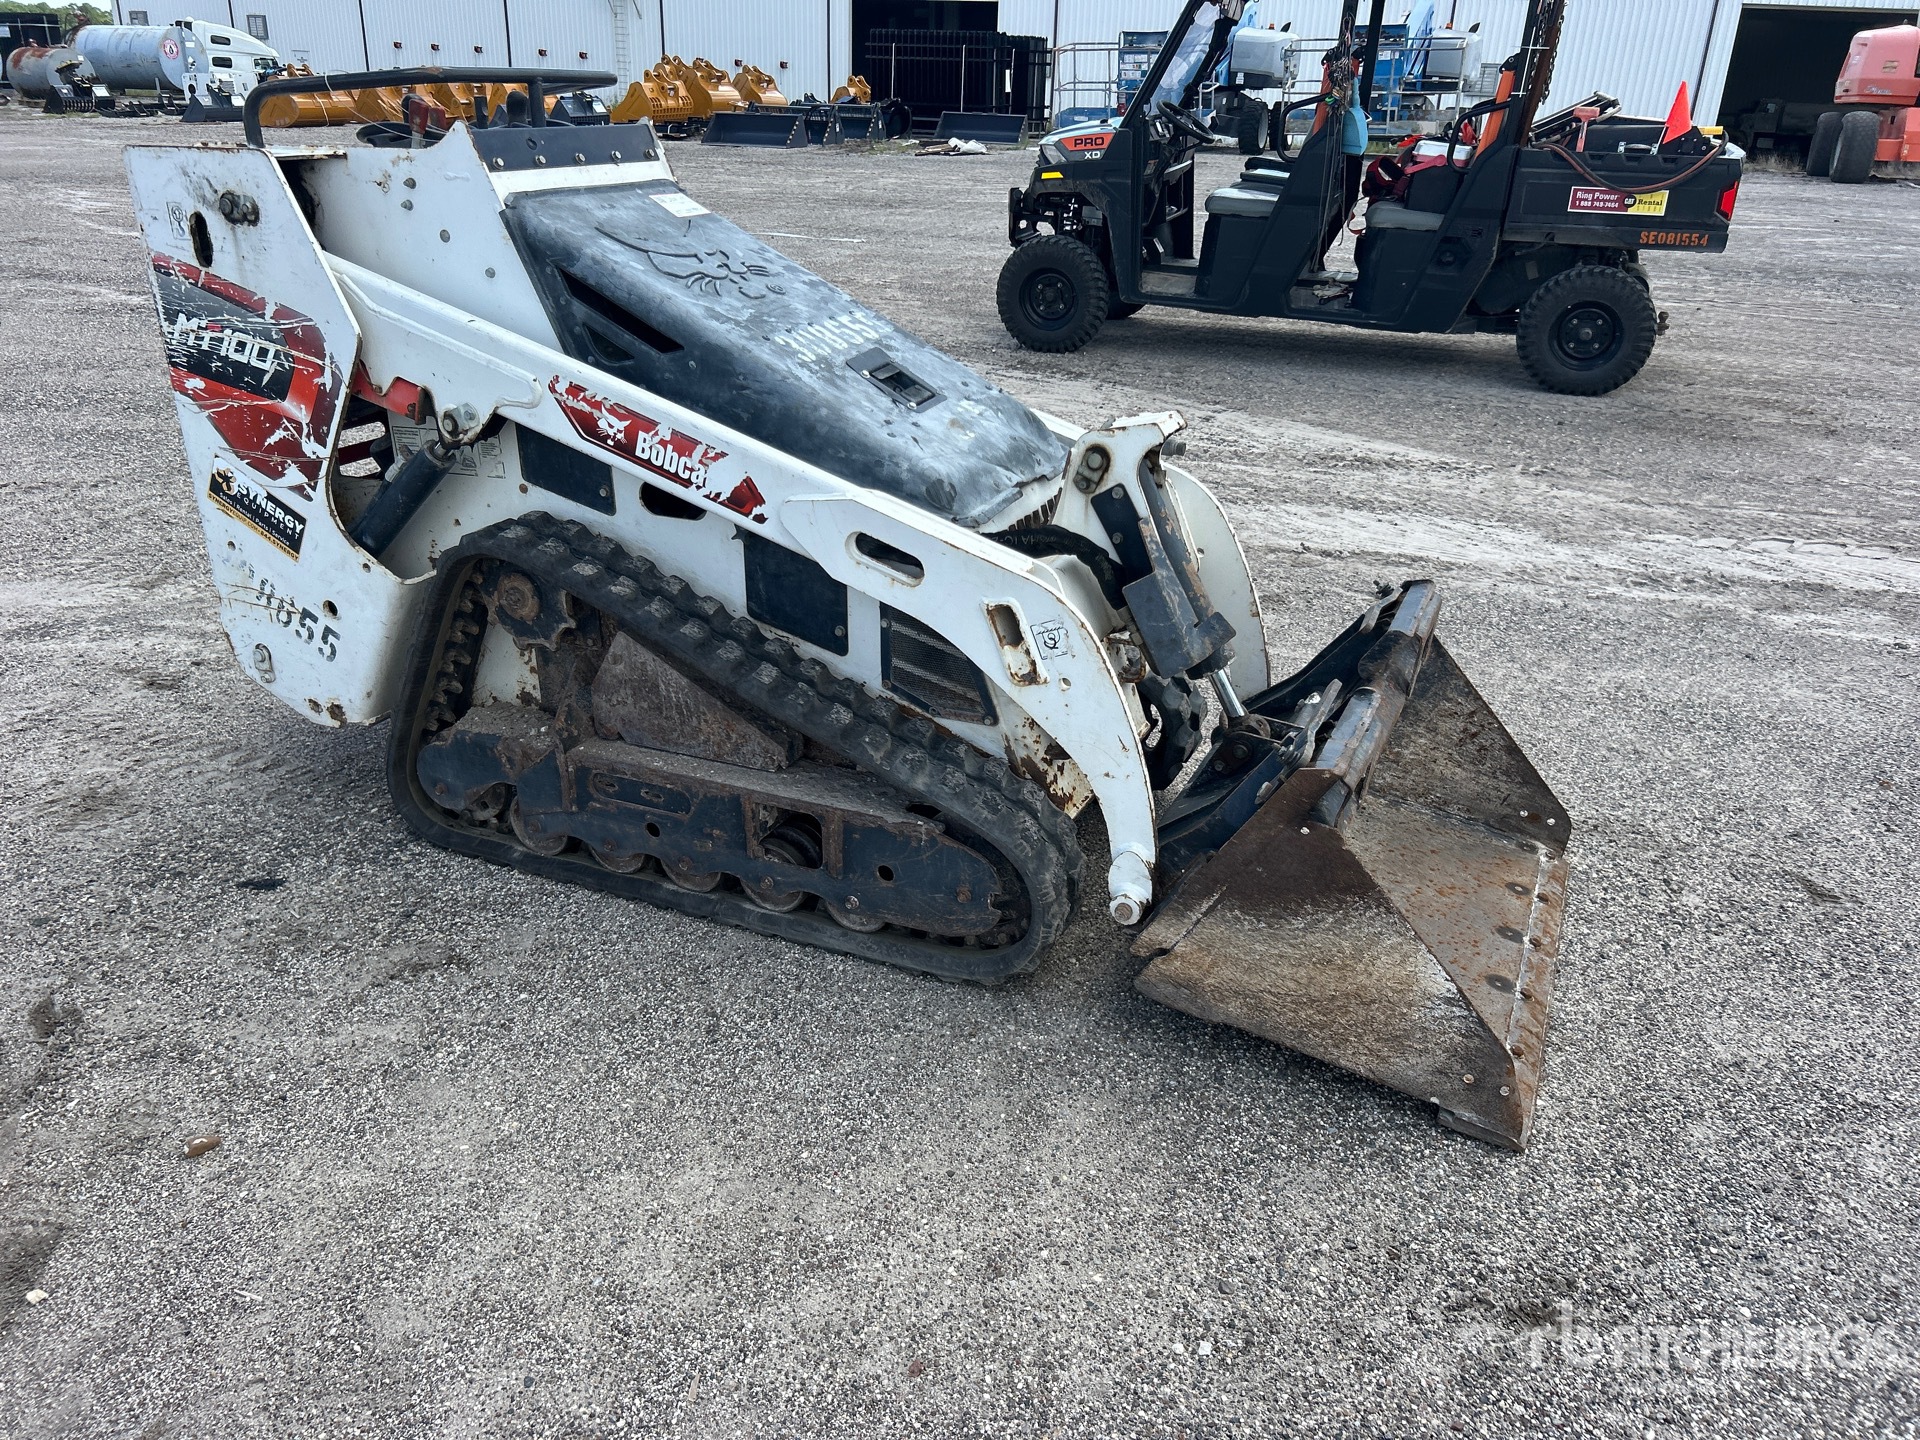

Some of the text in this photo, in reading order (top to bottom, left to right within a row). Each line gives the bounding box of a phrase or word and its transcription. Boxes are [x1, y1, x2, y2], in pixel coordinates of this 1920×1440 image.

[1074, 137, 1104, 147] PRO
[1084, 151, 1100, 159] XD
[1576, 191, 1618, 201] Ring Power
[1638, 198, 1663, 206] Rental
[1640, 231, 1709, 247] SE081554
[635, 429, 708, 489] Bobca
[236, 492, 300, 540] EQUIPMENT
[237, 482, 305, 535] SYNERGY
[219, 491, 290, 546] Sales Rental Parts Service
